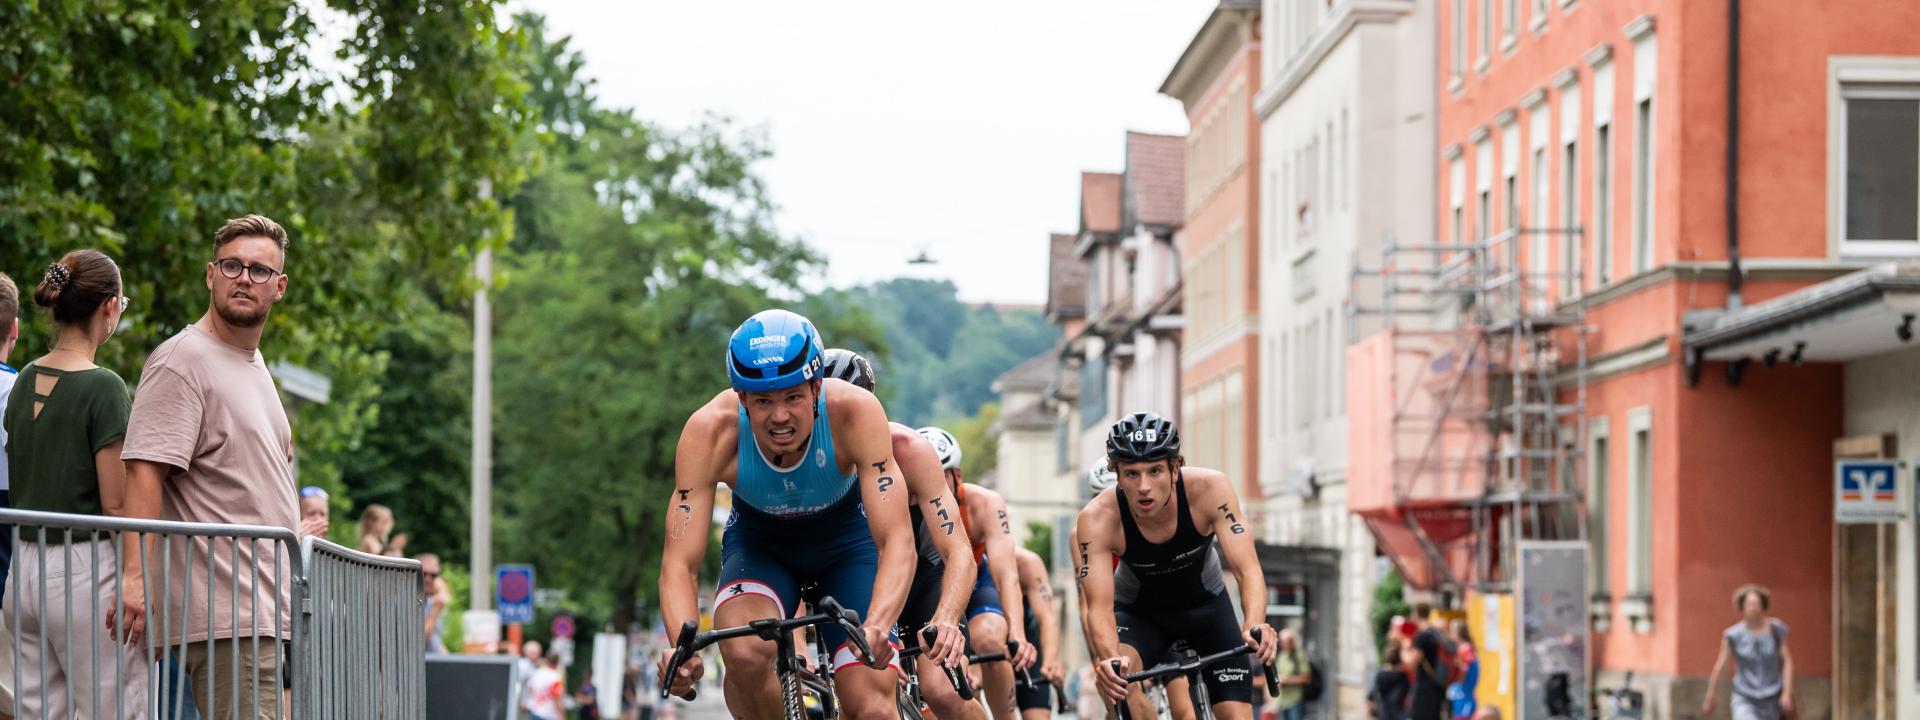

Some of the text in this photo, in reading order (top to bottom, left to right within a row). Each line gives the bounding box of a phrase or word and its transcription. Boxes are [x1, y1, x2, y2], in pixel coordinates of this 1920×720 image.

[750, 335, 786, 347] ERDINGER
[753, 356, 784, 366] CANYON
[811, 356, 821, 372] 21
[1127, 430, 1143, 442] 16
[1218, 673, 1244, 683] Sport
